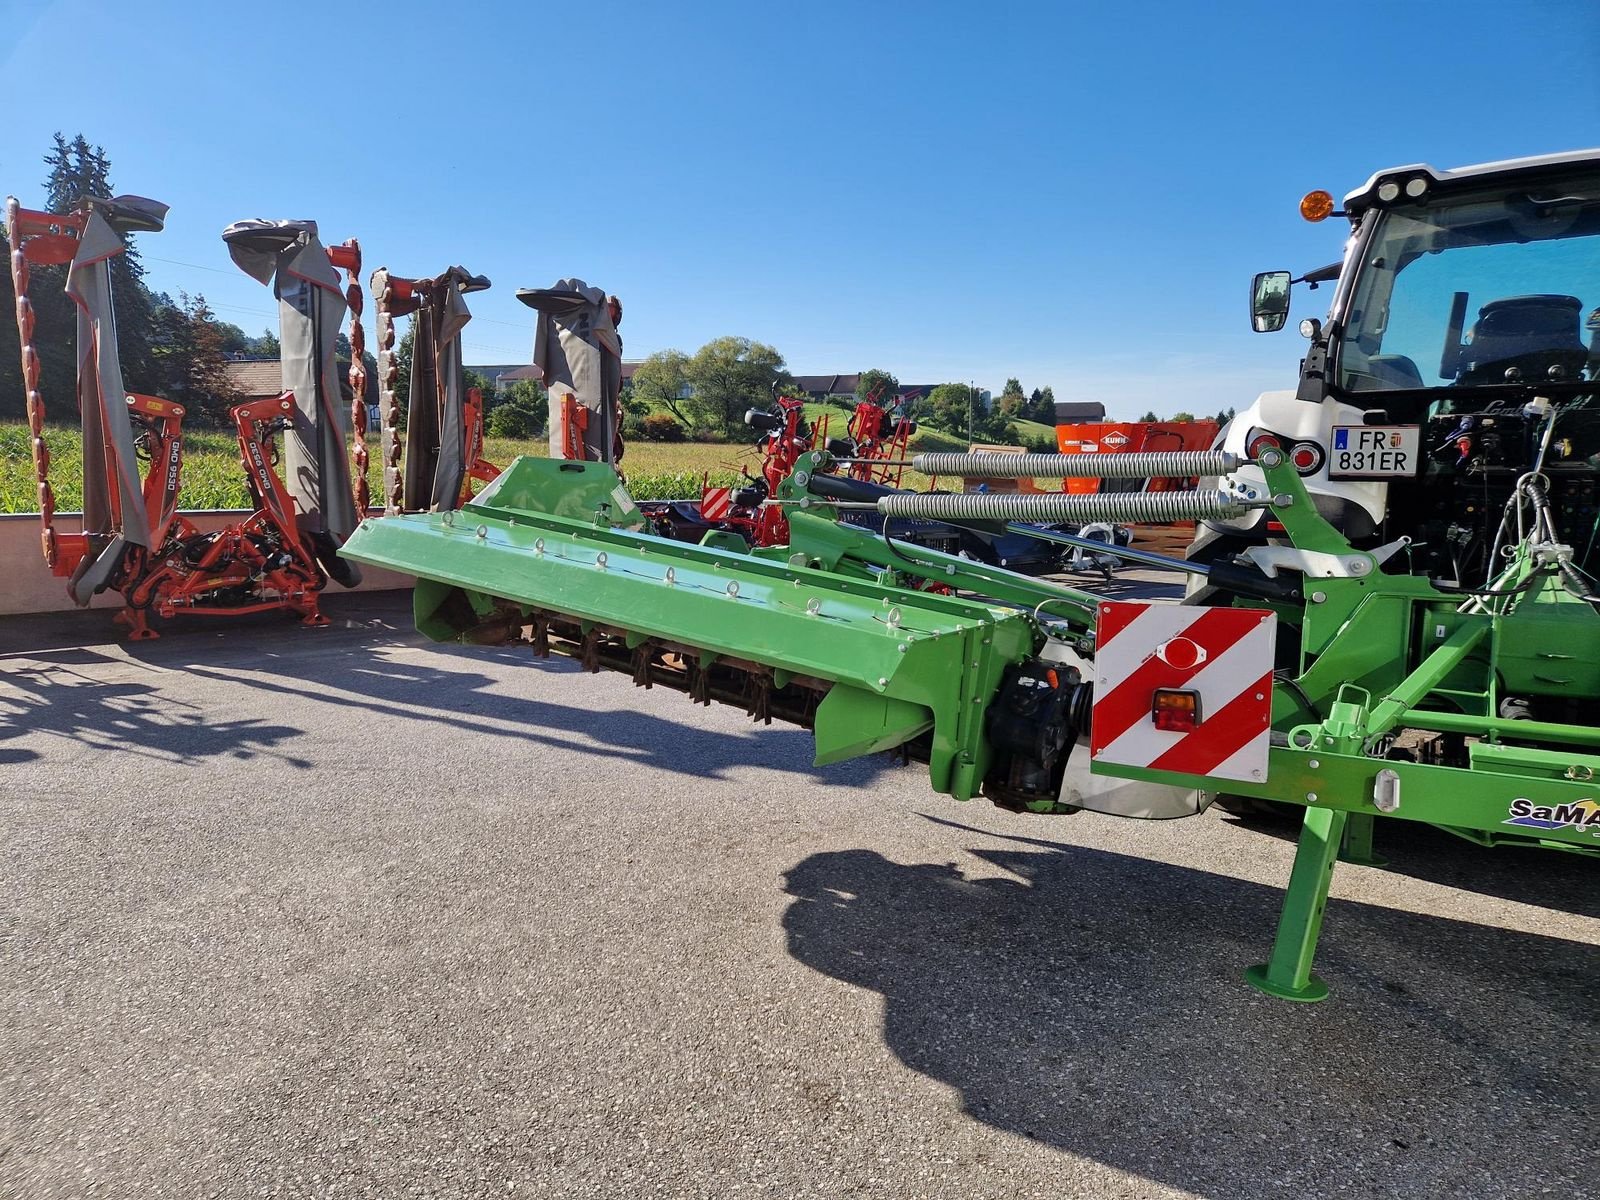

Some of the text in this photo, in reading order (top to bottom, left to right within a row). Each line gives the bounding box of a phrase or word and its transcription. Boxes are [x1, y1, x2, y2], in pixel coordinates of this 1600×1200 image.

[1359, 431, 1386, 450] FR
[168, 441, 180, 491] GMD 9530
[249, 442, 271, 489] GMD 9530
[1339, 451, 1407, 471] 831ER
